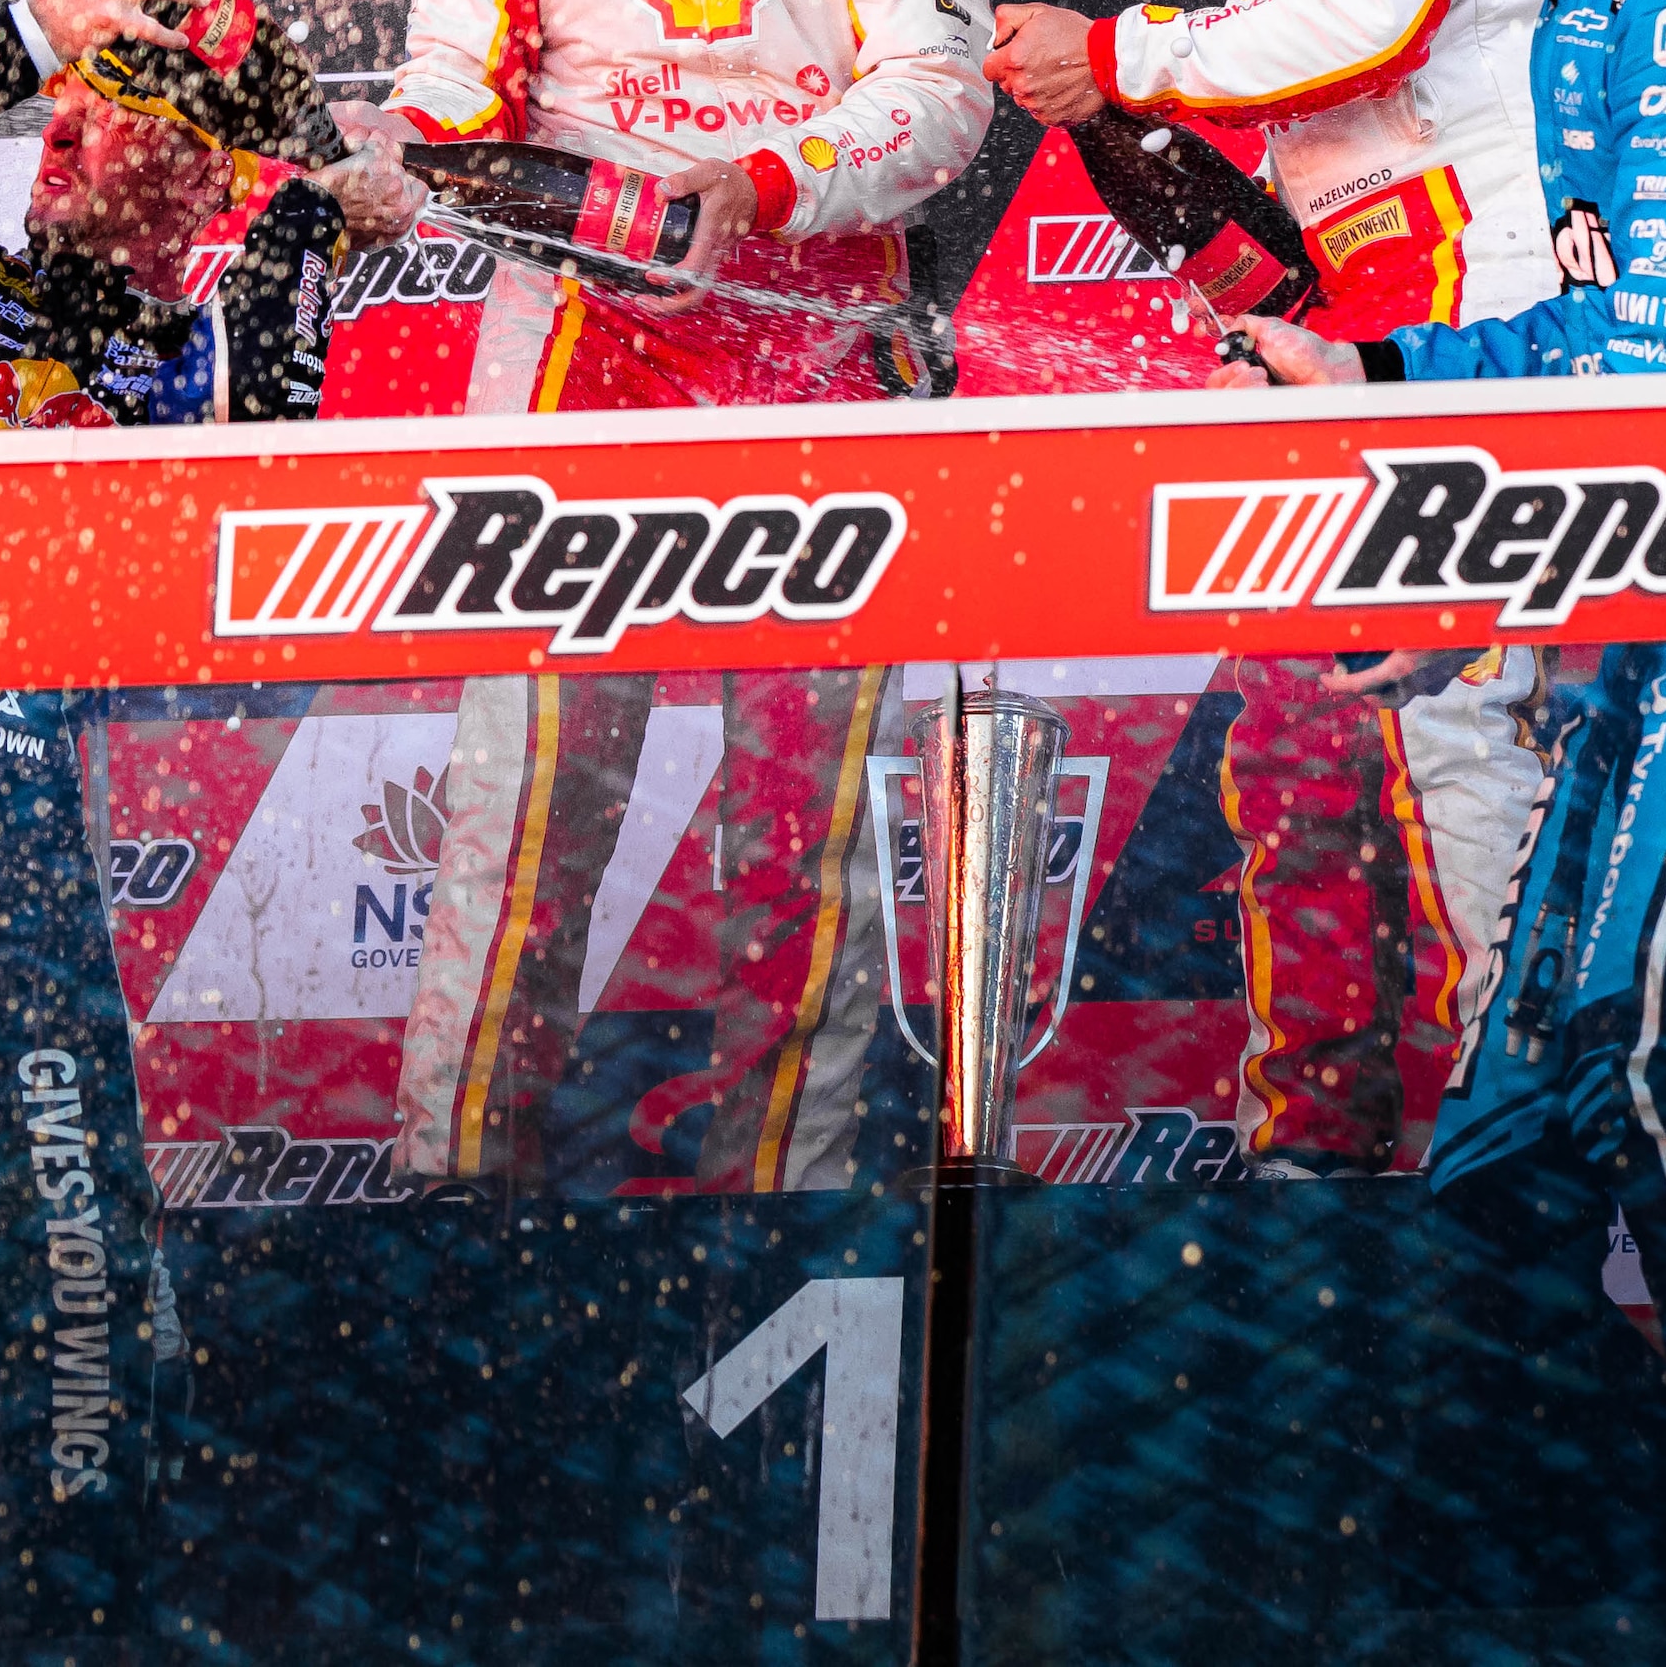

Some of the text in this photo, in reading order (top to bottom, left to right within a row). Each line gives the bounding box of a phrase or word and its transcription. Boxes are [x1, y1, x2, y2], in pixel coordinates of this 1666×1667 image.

[918, 41, 971, 60] greyhound
[606, 63, 681, 98] Shell
[610, 95, 817, 135] V-Power
[833, 130, 857, 152] hell
[847, 128, 917, 170] -Powe
[1309, 168, 1393, 214] HAZELWOOD
[1355, 204, 1401, 240] TWENTY
[295, 248, 328, 348] Red Bull
[372, 475, 907, 656] Repco
[16, 1048, 111, 1500] GIVES YOU WINGS
[681, 1276, 905, 1621] 1
